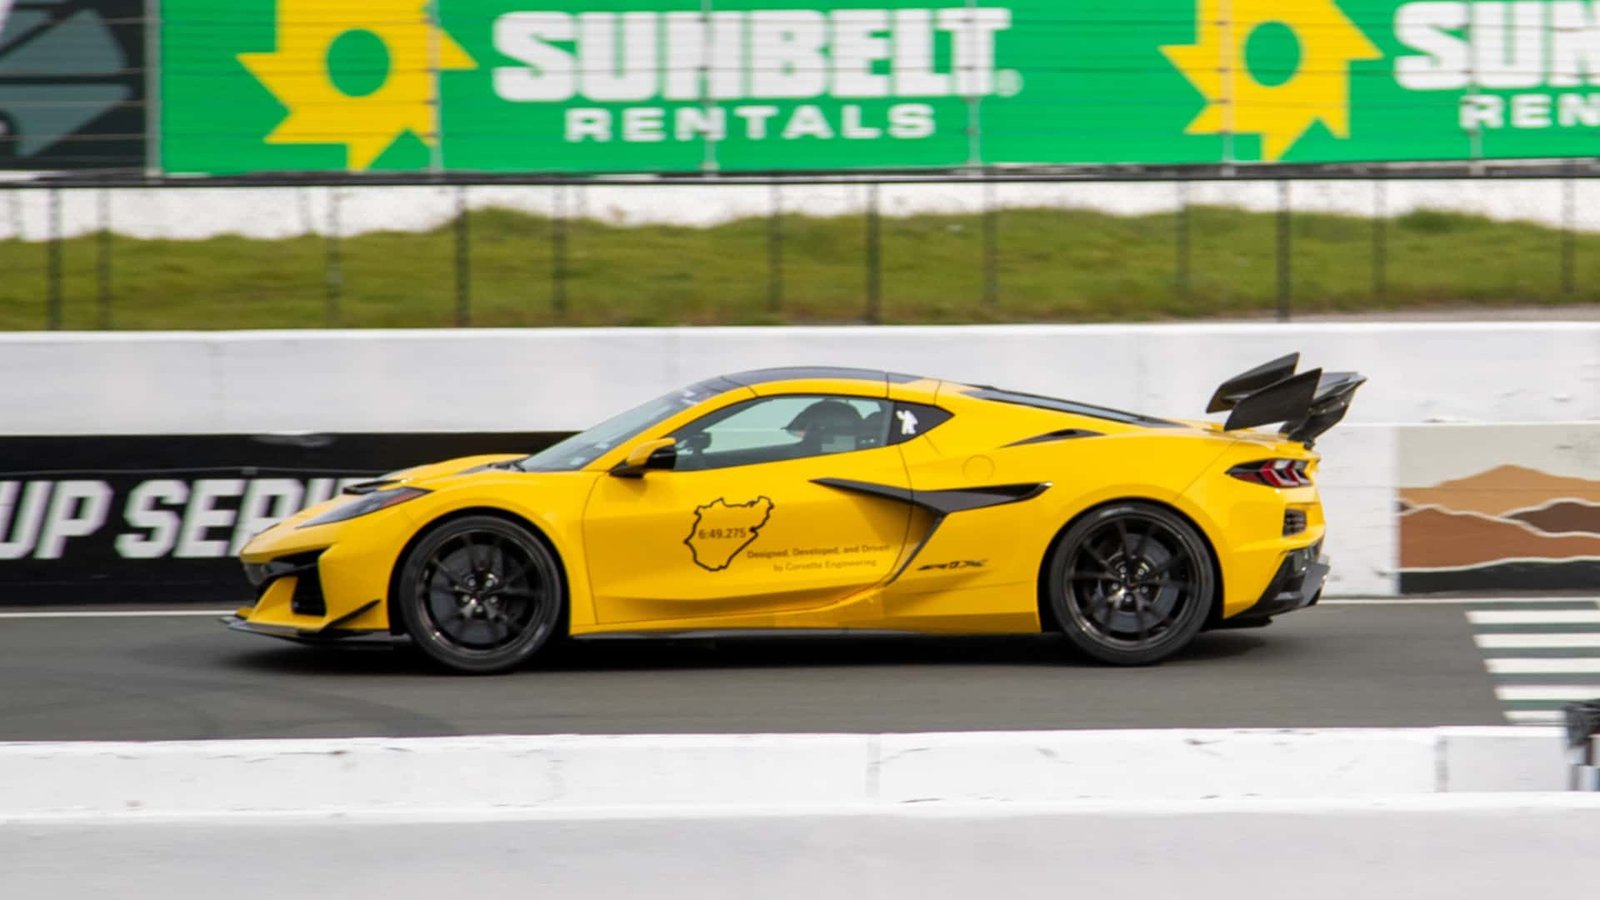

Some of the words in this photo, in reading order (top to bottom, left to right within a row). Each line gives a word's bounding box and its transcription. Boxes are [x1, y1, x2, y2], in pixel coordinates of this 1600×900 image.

[492, 7, 1011, 101] SUNBELT
[565, 104, 936, 143] RENTALS
[114, 479, 375, 559] SER
[698, 527, 747, 540] 6:49.275
